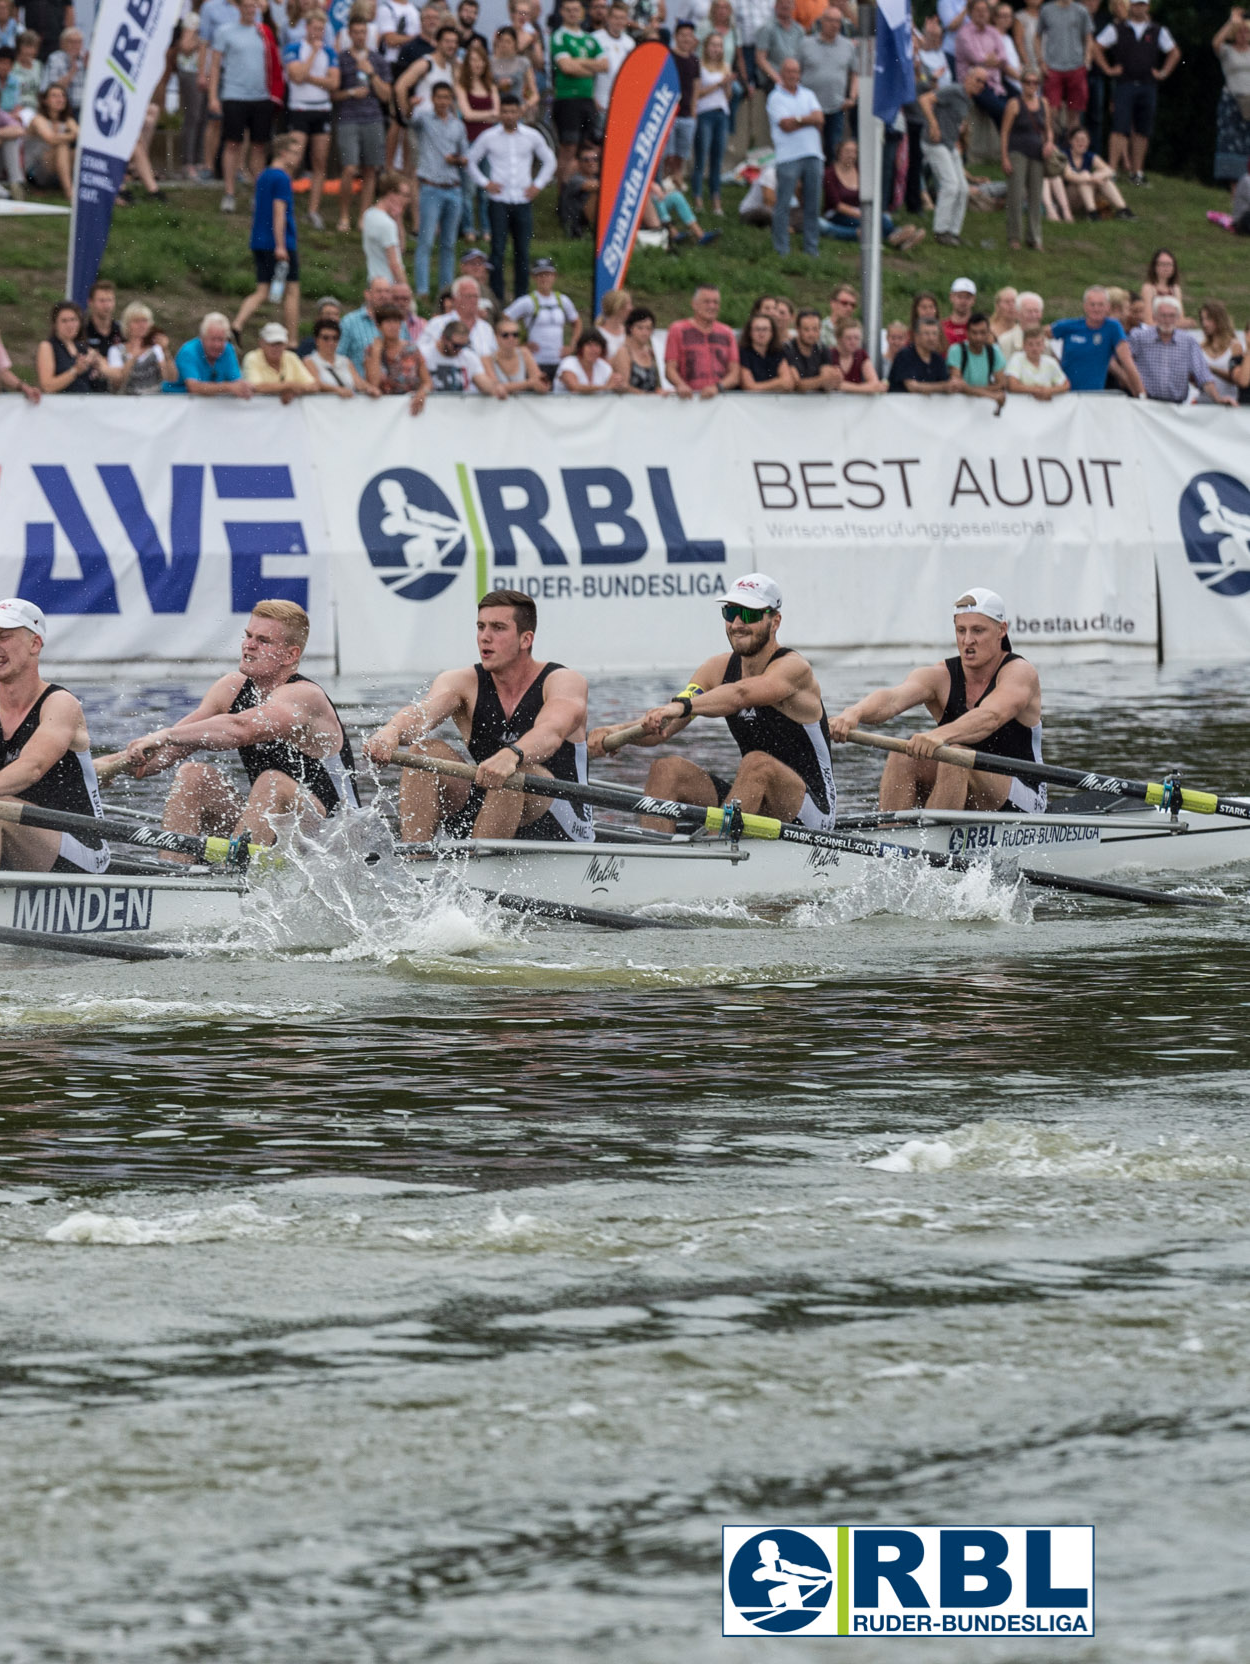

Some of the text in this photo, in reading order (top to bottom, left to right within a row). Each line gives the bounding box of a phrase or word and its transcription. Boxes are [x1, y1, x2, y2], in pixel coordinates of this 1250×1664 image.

[602, 83, 676, 278] Sparda-Bank
[752, 456, 1122, 511] BEST AUDIT
[472, 465, 727, 567] RBL
[493, 574, 727, 600] RUDER-BUNDESLIGA
[965, 825, 998, 850] RBL
[14, 887, 152, 932] MINDEN
